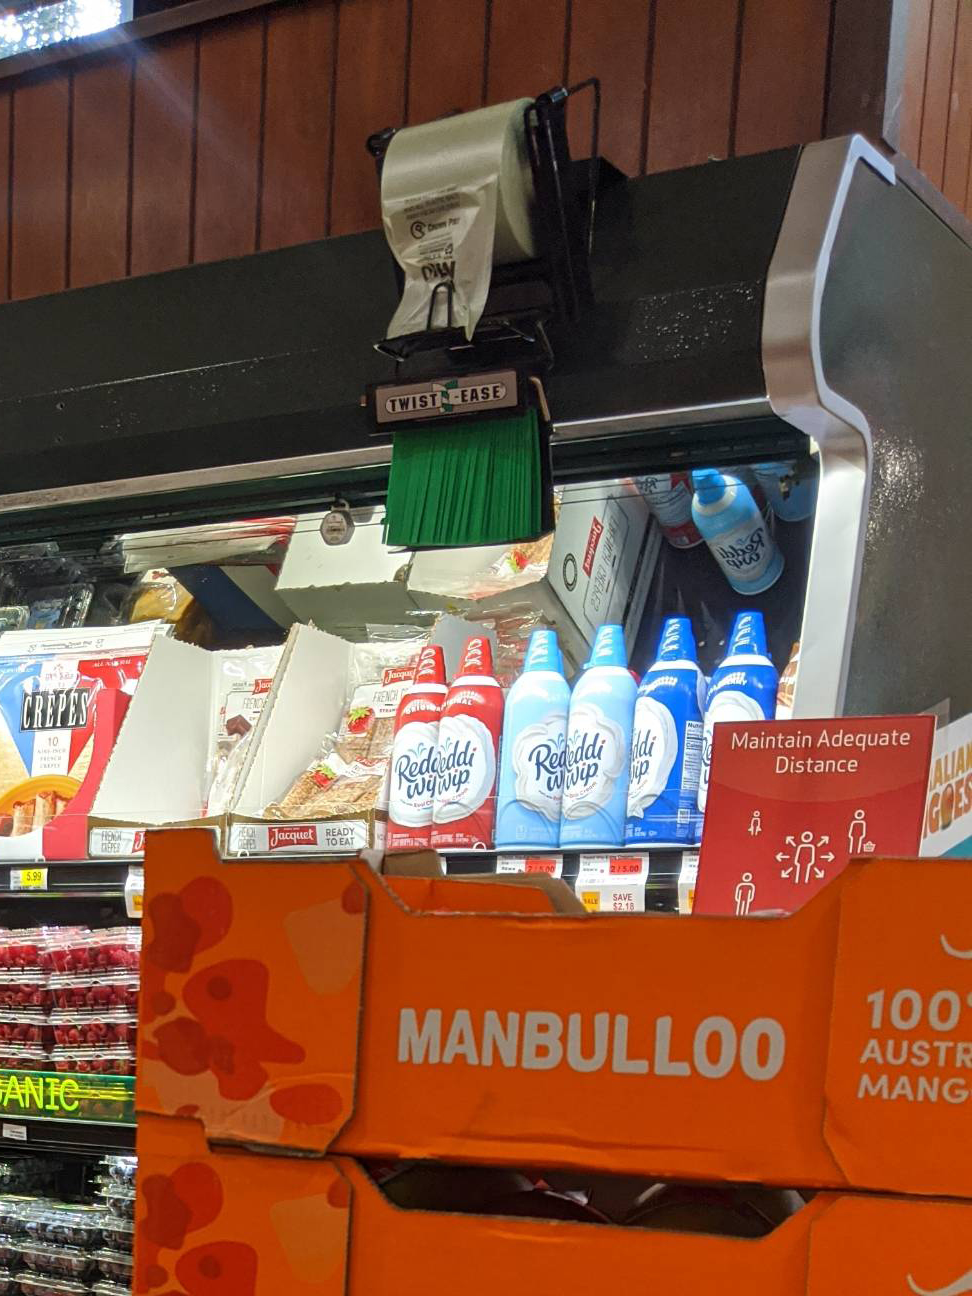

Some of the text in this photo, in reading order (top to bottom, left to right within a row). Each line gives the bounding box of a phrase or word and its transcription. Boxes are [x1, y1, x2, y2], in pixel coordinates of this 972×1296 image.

[389, 393, 437, 411] TWIST
[730, 728, 911, 752] Maintain Adequate
[775, 755, 859, 774] Distance
[270, 828, 314, 850] Jacquet
[326, 828, 355, 838] READY
[326, 837, 355, 847] TO EAT
[26, 871, 42, 882] 5.99
[613, 893, 633, 901] SAVE
[613, 902, 635, 912] $2.18
[867, 987, 972, 1032] 100
[397, 1008, 786, 1081] MANBULLOO
[857, 1073, 972, 1104] MANG
